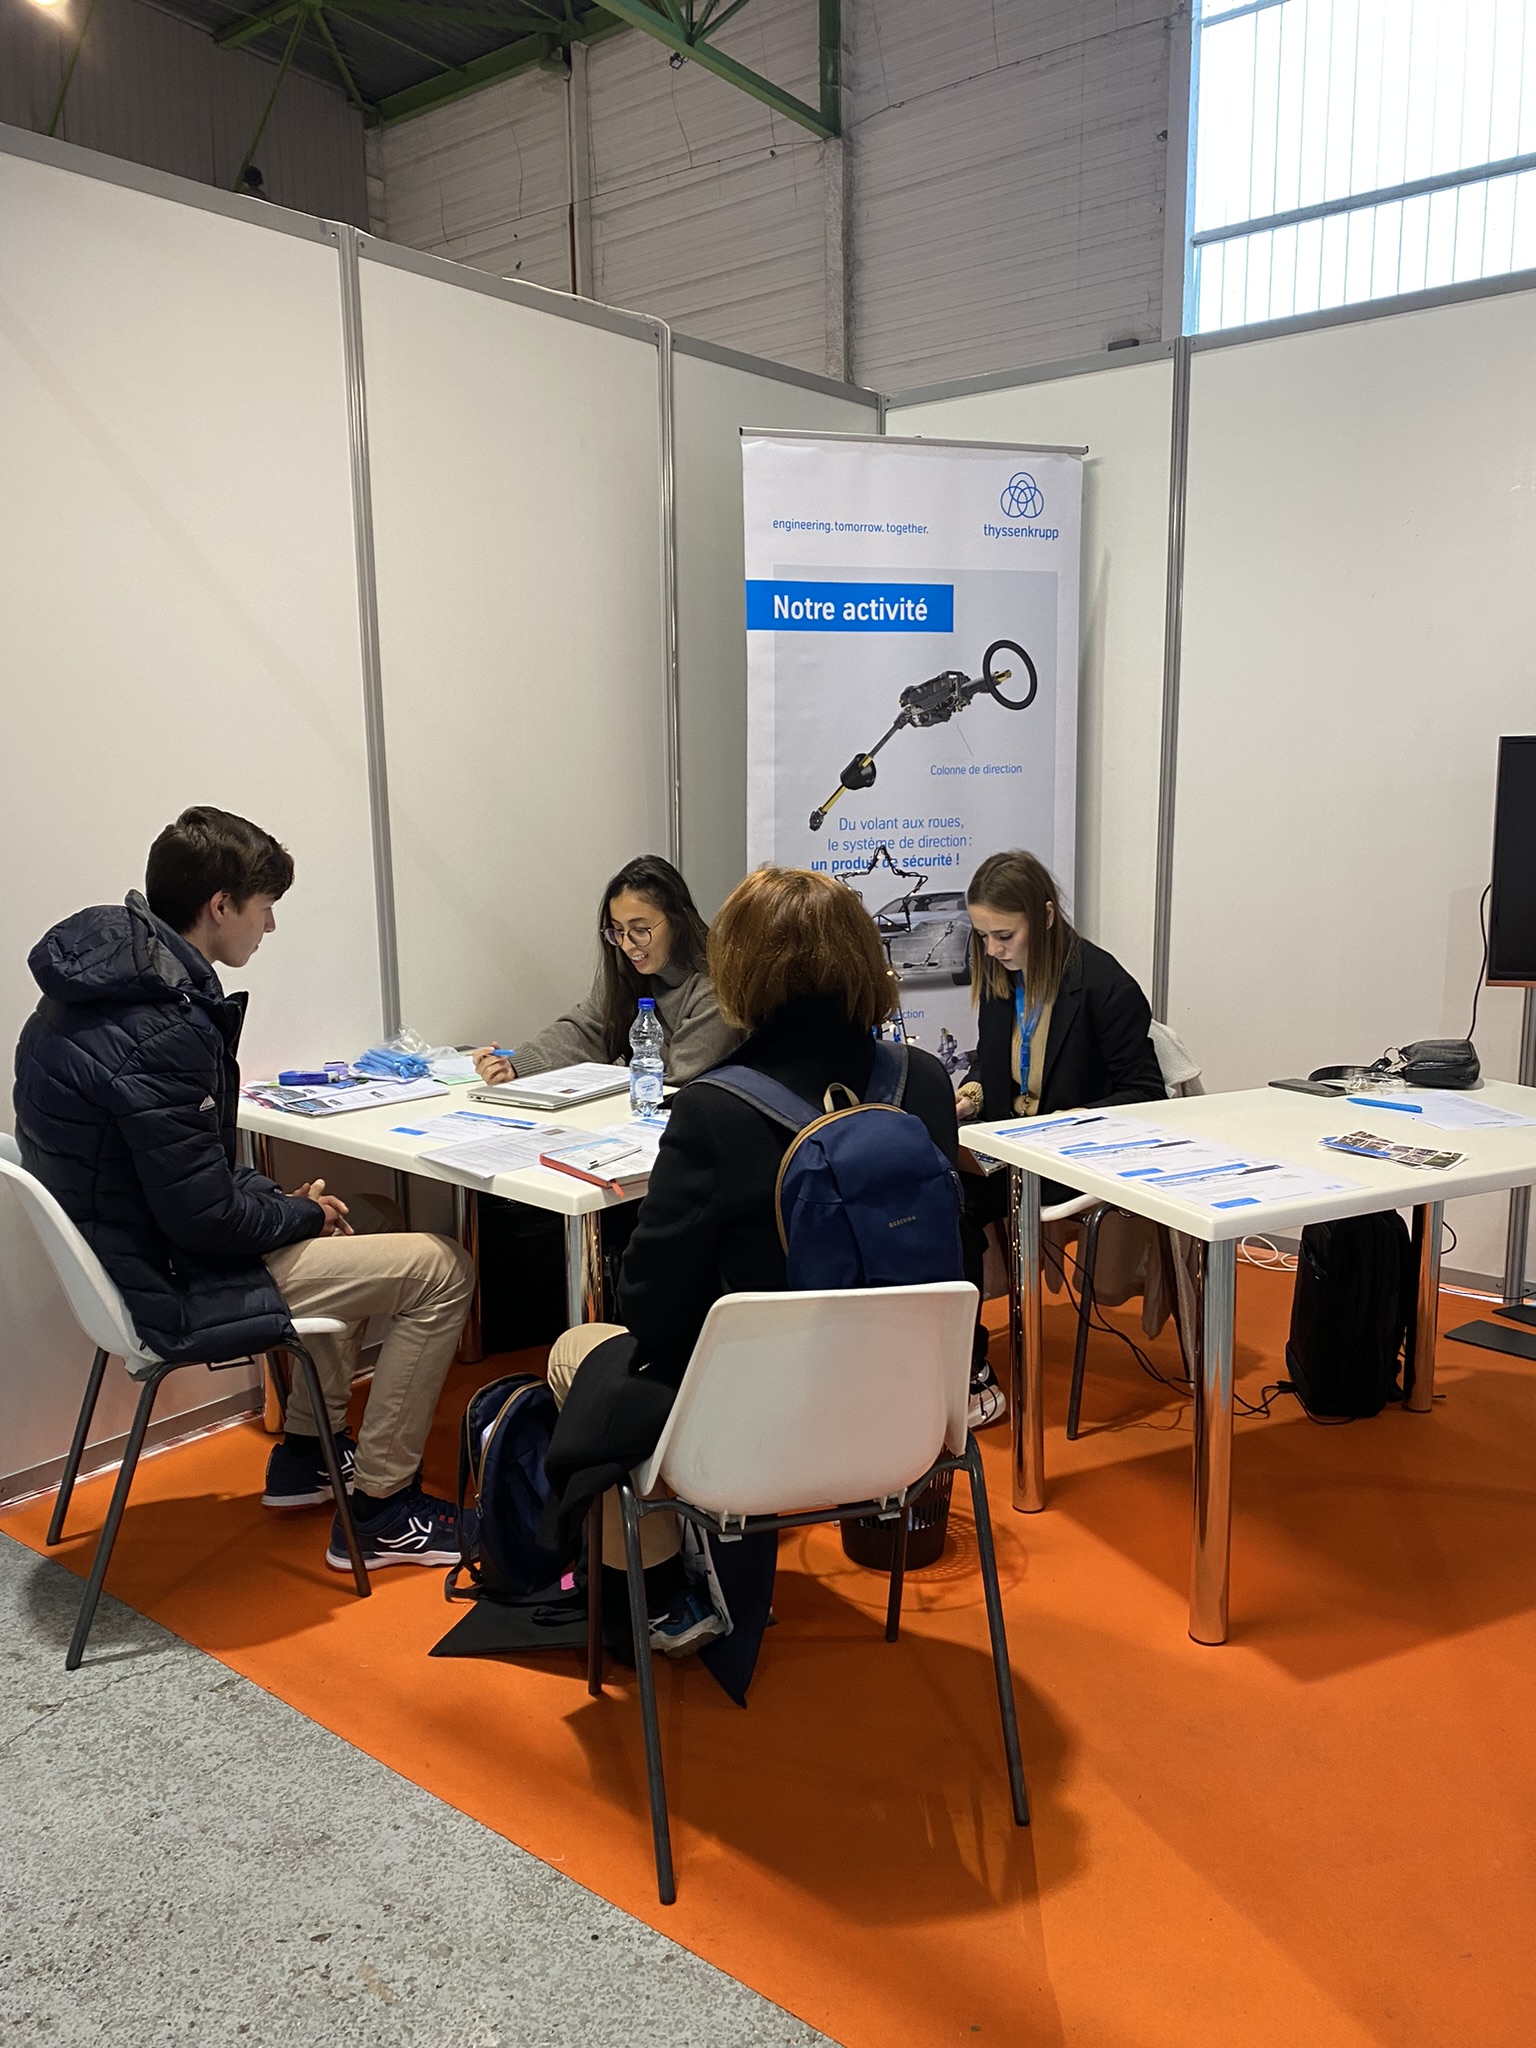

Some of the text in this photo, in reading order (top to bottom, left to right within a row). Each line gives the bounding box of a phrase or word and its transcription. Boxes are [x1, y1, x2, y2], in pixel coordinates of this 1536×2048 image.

[983, 523, 1059, 540] thyssenkrupp
[773, 594, 928, 622] Notre activité
[930, 763, 1022, 776] Colonne de direction
[839, 816, 965, 831] Du volant aux roues,
[828, 838, 839, 851] le
[842, 836, 895, 853] système
[899, 836, 914, 849] de
[811, 859, 827, 871] un
[831, 856, 878, 873] produ
[902, 853, 952, 868] sécurité
